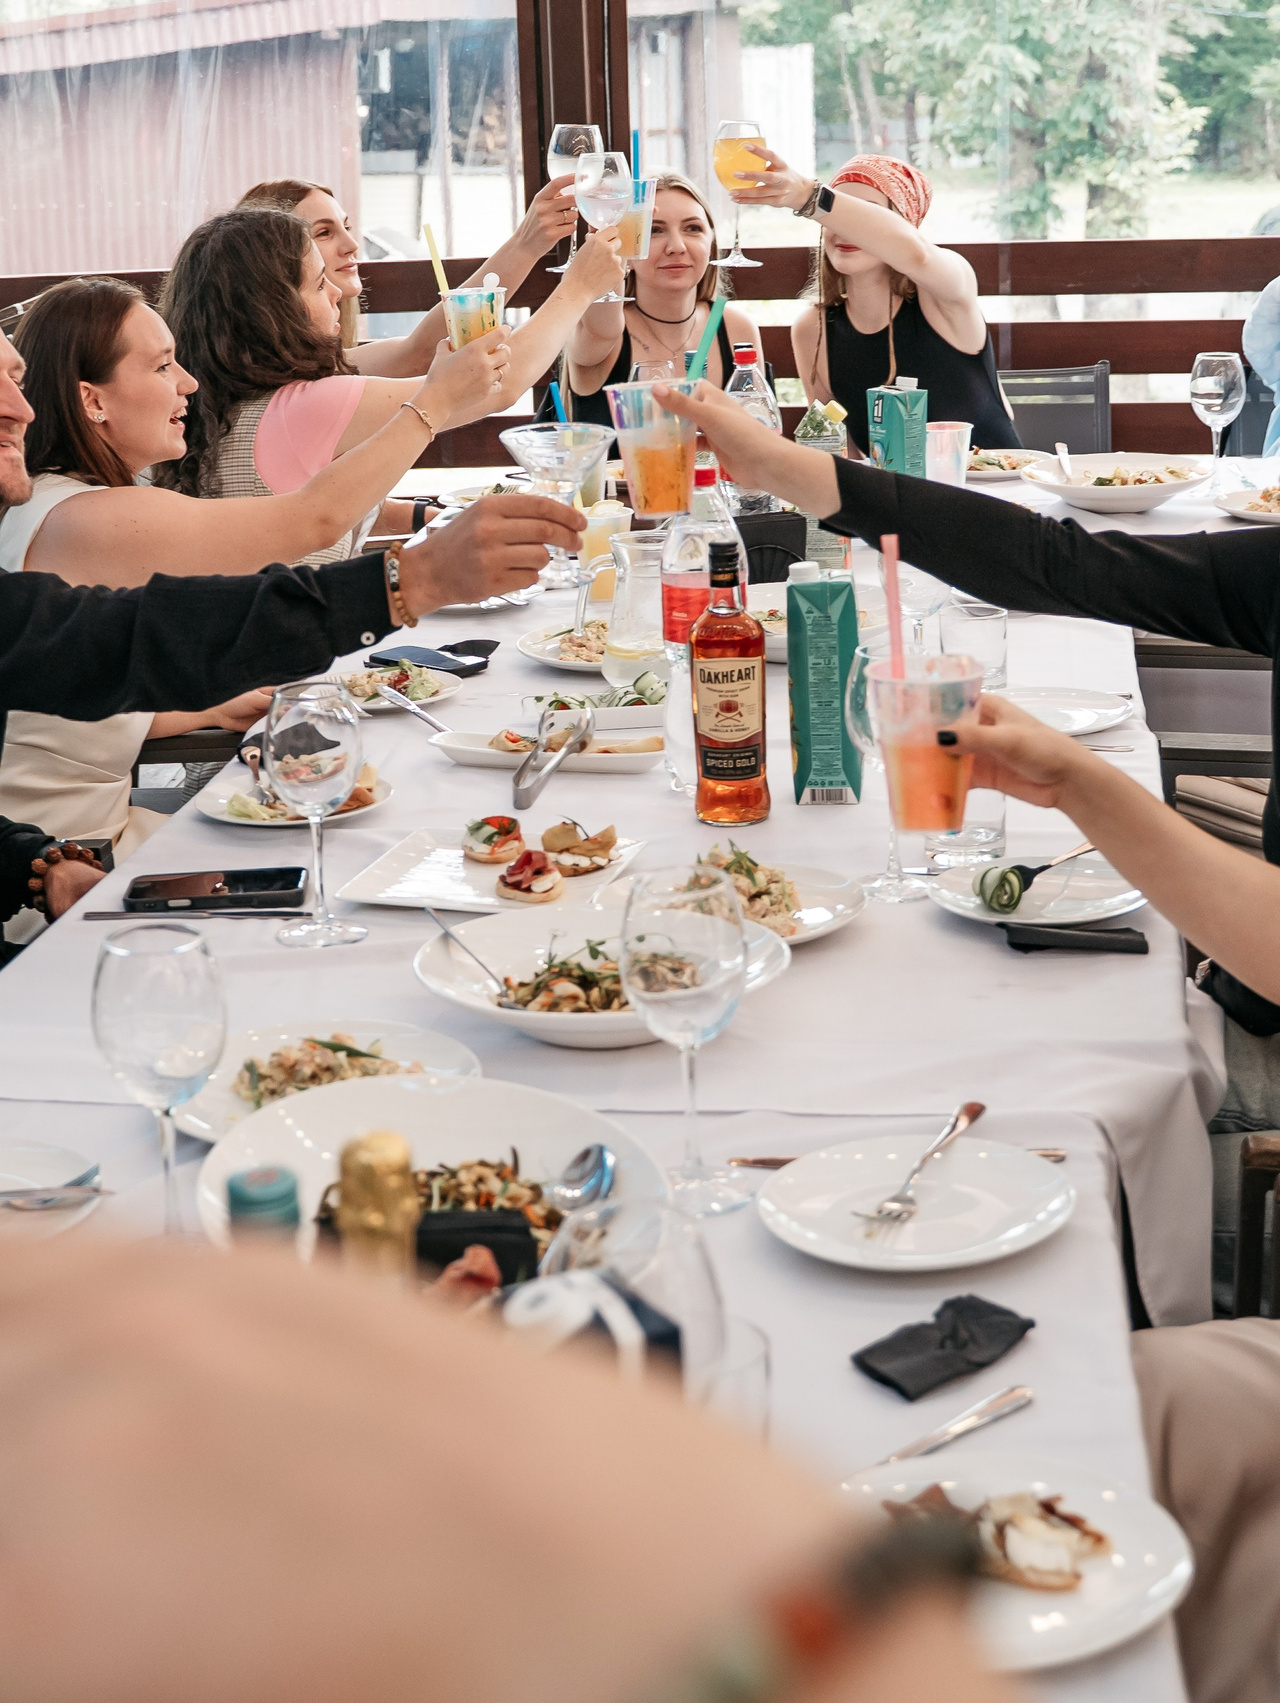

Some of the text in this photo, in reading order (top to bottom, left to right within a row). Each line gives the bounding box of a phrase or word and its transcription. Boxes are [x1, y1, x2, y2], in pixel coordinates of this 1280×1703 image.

[699, 666, 756, 684] OAKHEART
[706, 757, 756, 768] SPICED GOLD
